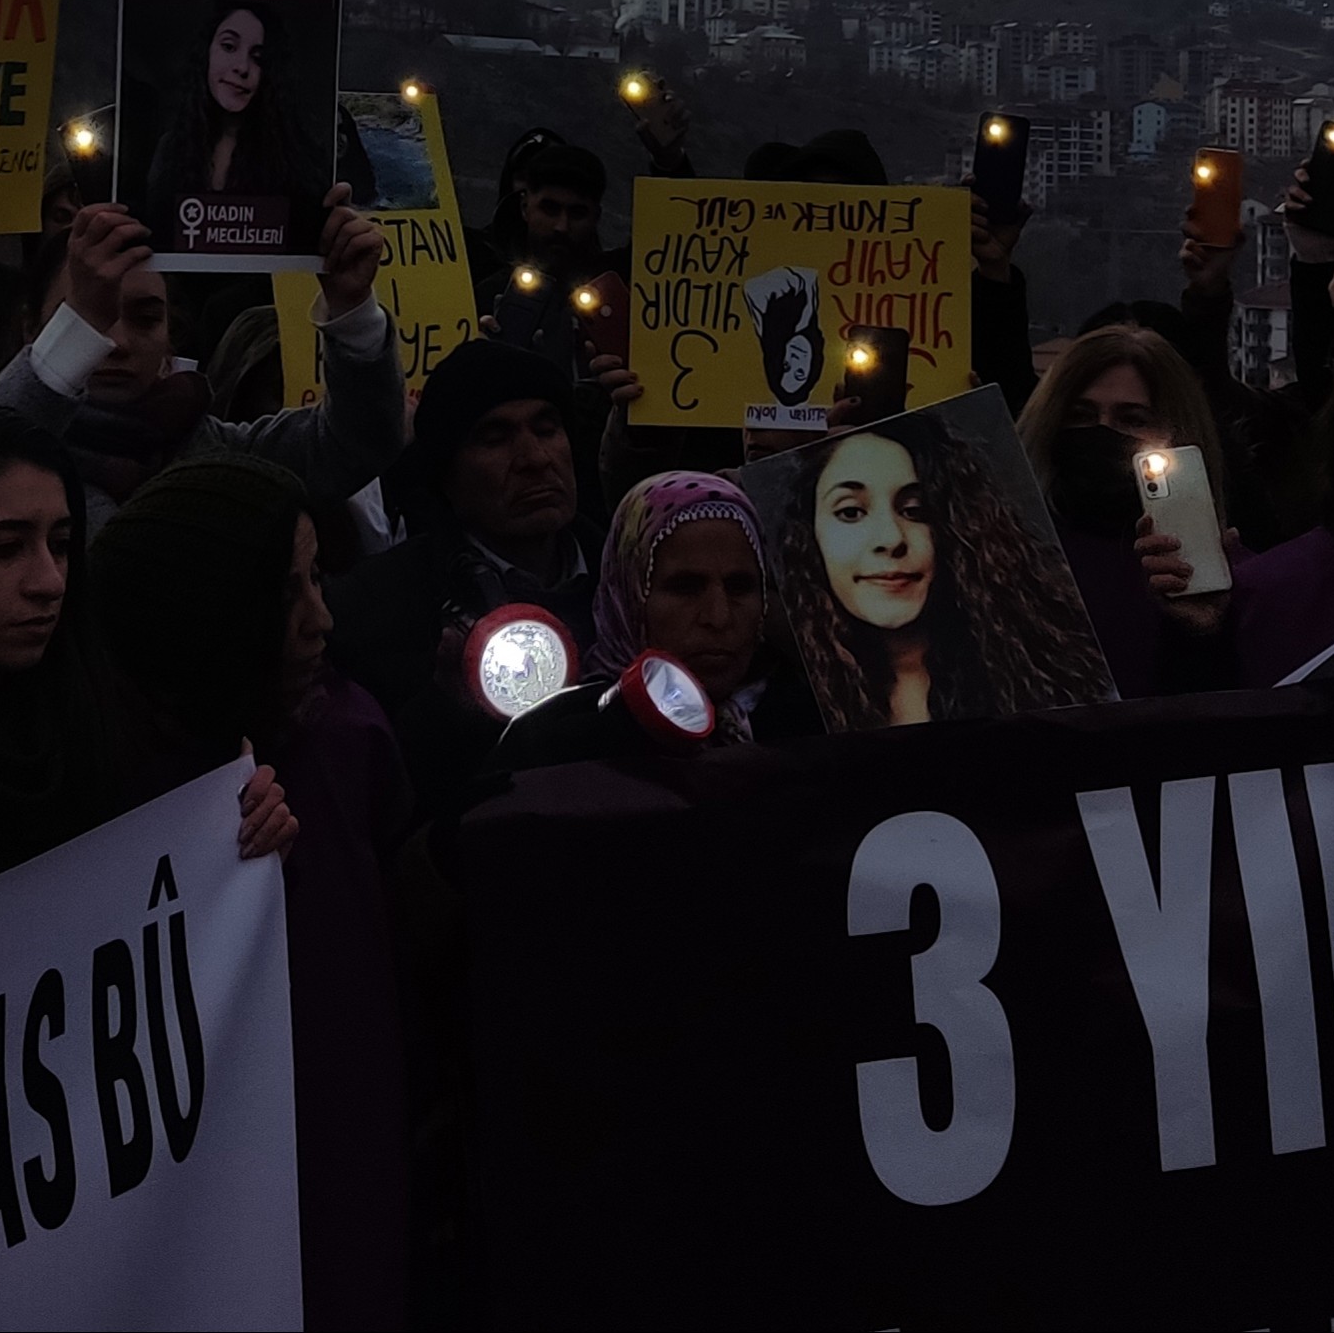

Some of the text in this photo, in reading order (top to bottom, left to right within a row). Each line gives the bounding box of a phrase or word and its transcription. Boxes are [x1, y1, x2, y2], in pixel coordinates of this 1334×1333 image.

[206, 224, 284, 245] MECLİSLERİ
[207, 204, 255, 223] KADIN
[792, 197, 923, 234] EKMEK
[644, 234, 750, 276] KAYIP
[827, 238, 945, 287] KAYIP
[634, 278, 741, 333] YILDIR
[671, 329, 718, 410] 3
[91, 854, 204, 1197] BÛ
[847, 810, 1016, 1206] 3
